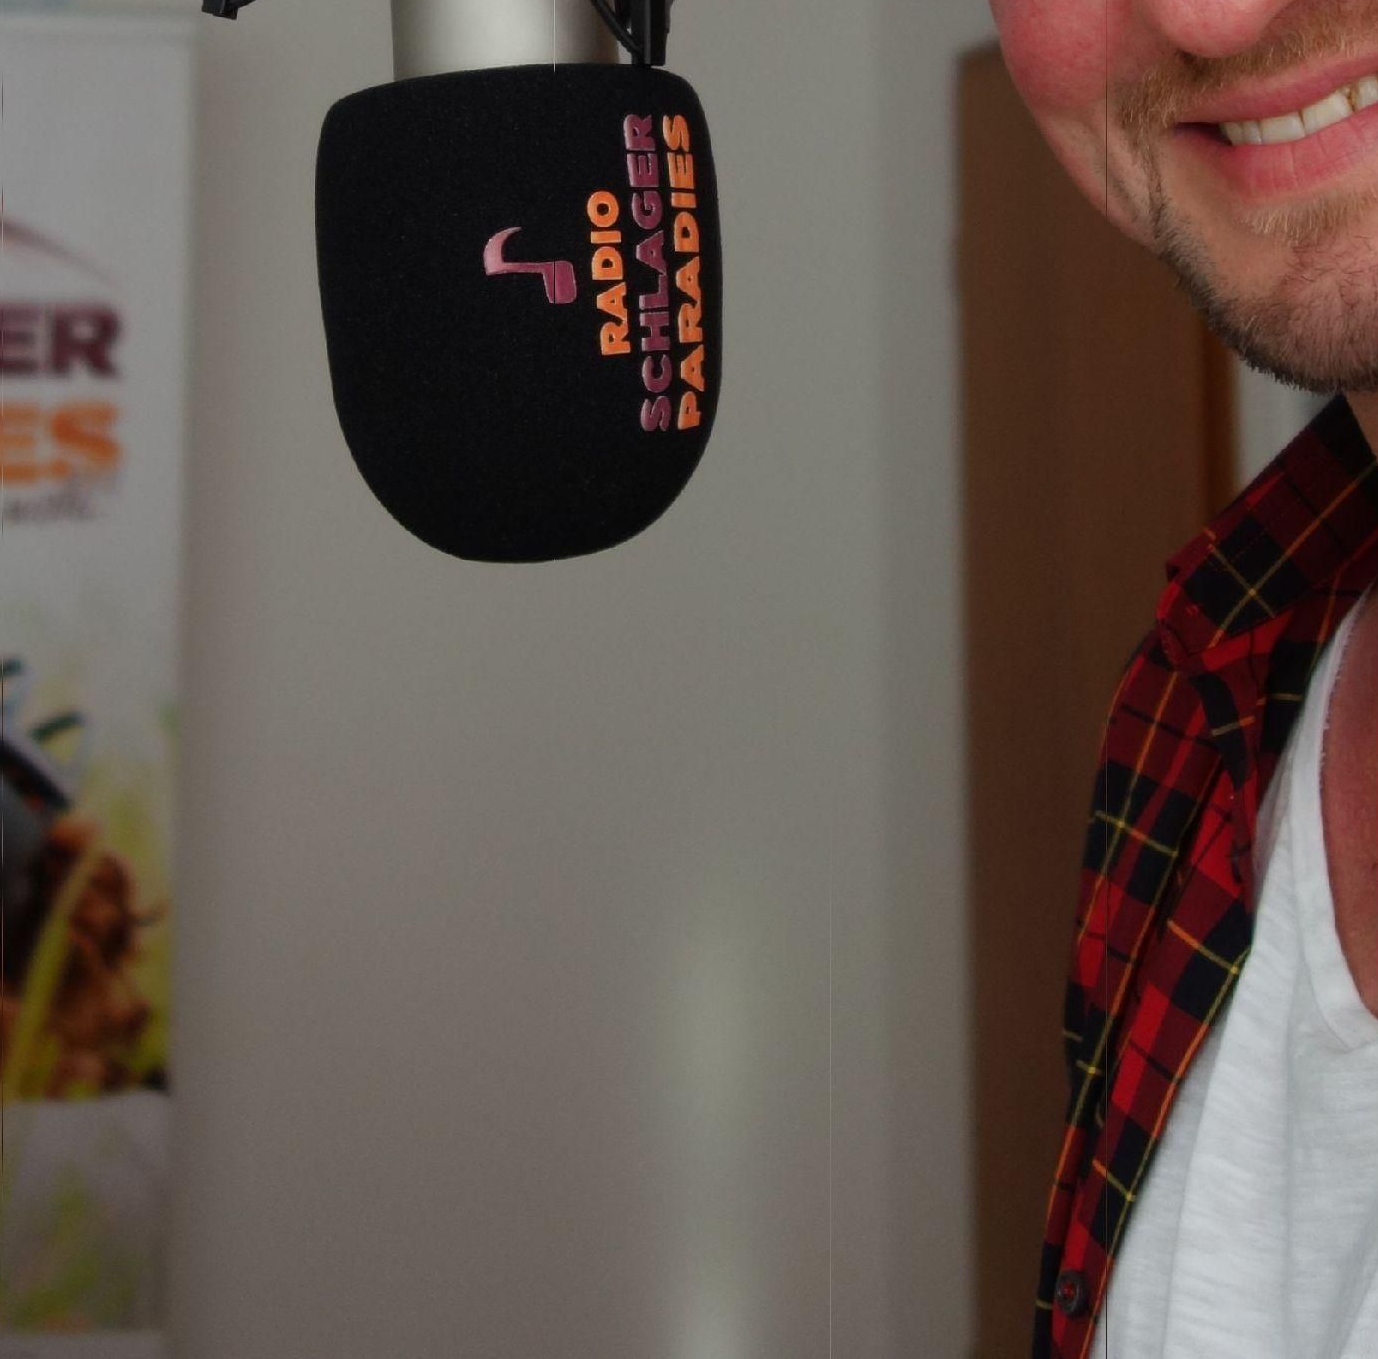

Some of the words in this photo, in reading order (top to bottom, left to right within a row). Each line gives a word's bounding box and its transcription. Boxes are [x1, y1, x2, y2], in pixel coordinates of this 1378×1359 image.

[586, 190, 631, 356] RADIO
[623, 113, 670, 433] SCHLAGER
[662, 114, 705, 431] PARADIES
